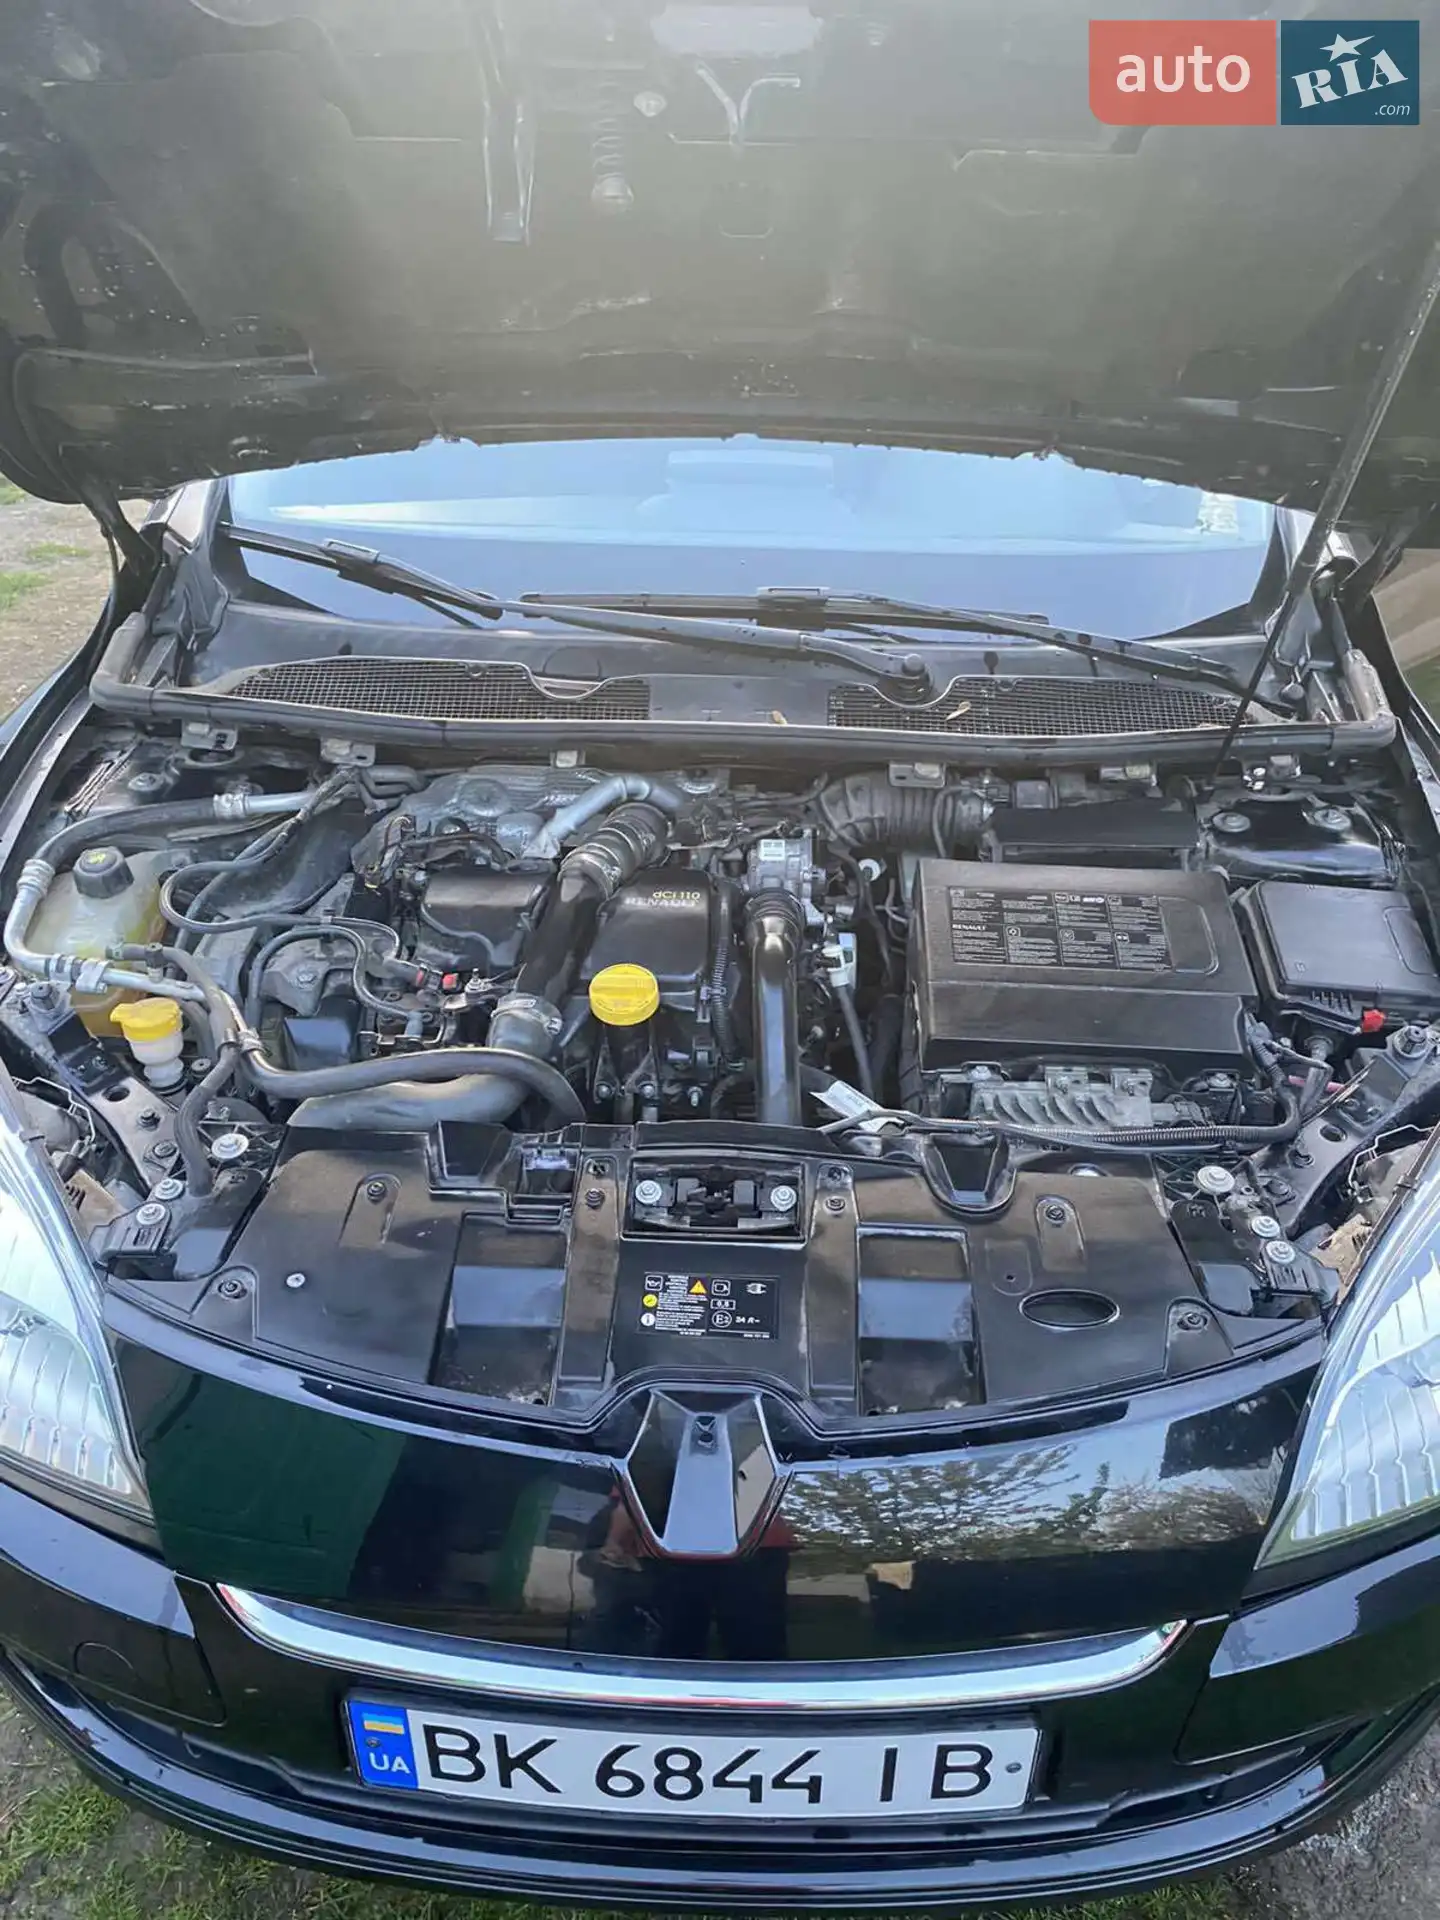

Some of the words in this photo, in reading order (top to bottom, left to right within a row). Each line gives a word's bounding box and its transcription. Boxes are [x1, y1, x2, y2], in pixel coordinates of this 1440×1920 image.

[368, 1752, 411, 1775] UA
[422, 1723, 563, 1794] BK
[595, 1743, 823, 1804] 6844
